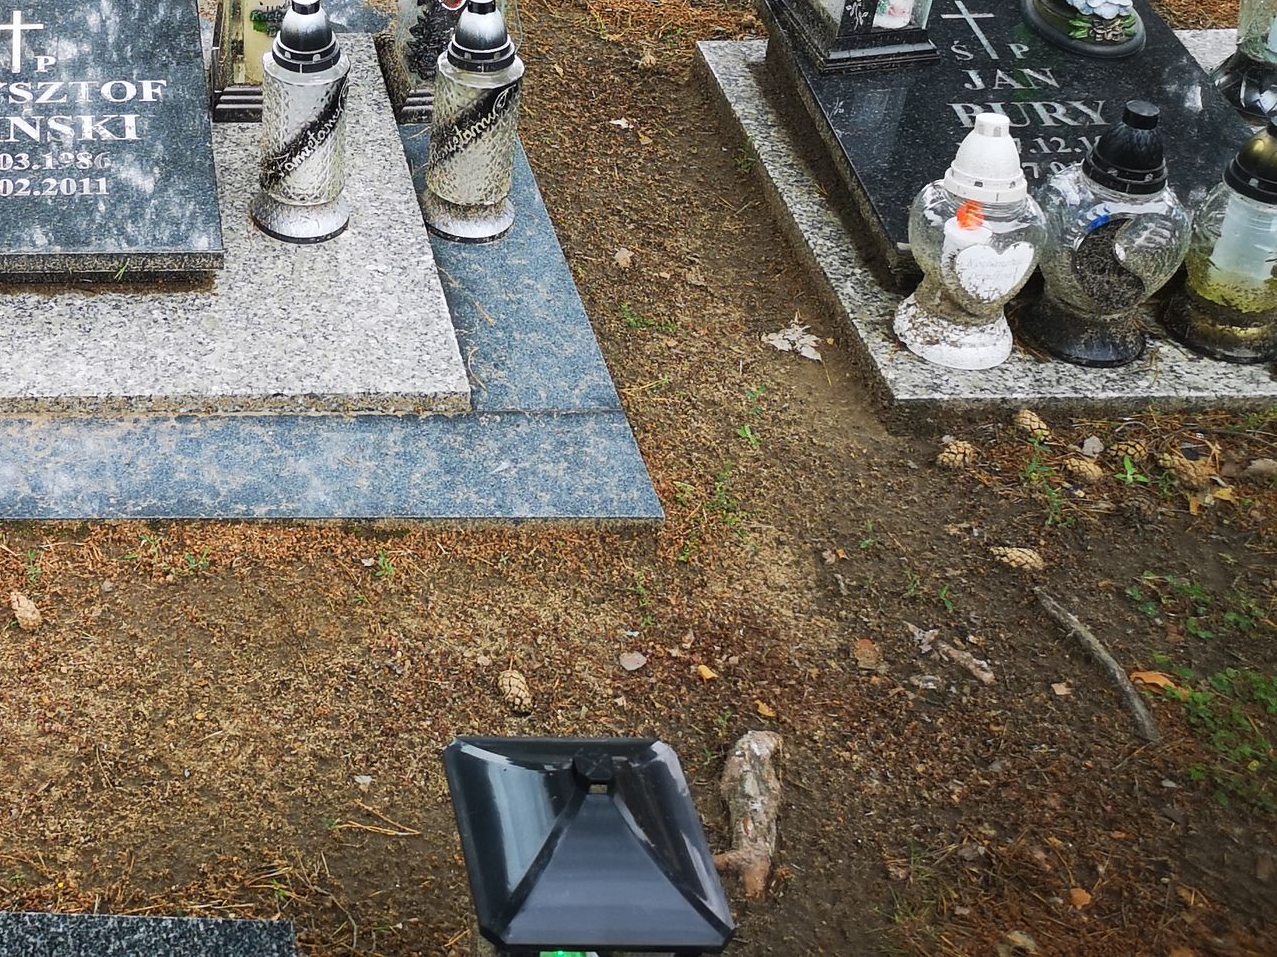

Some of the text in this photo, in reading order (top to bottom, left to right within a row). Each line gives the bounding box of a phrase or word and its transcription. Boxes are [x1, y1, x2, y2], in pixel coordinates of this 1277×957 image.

[1008, 43, 1029, 59] P
[34, 55, 56, 73] P
[962, 67, 1061, 90] JAN
